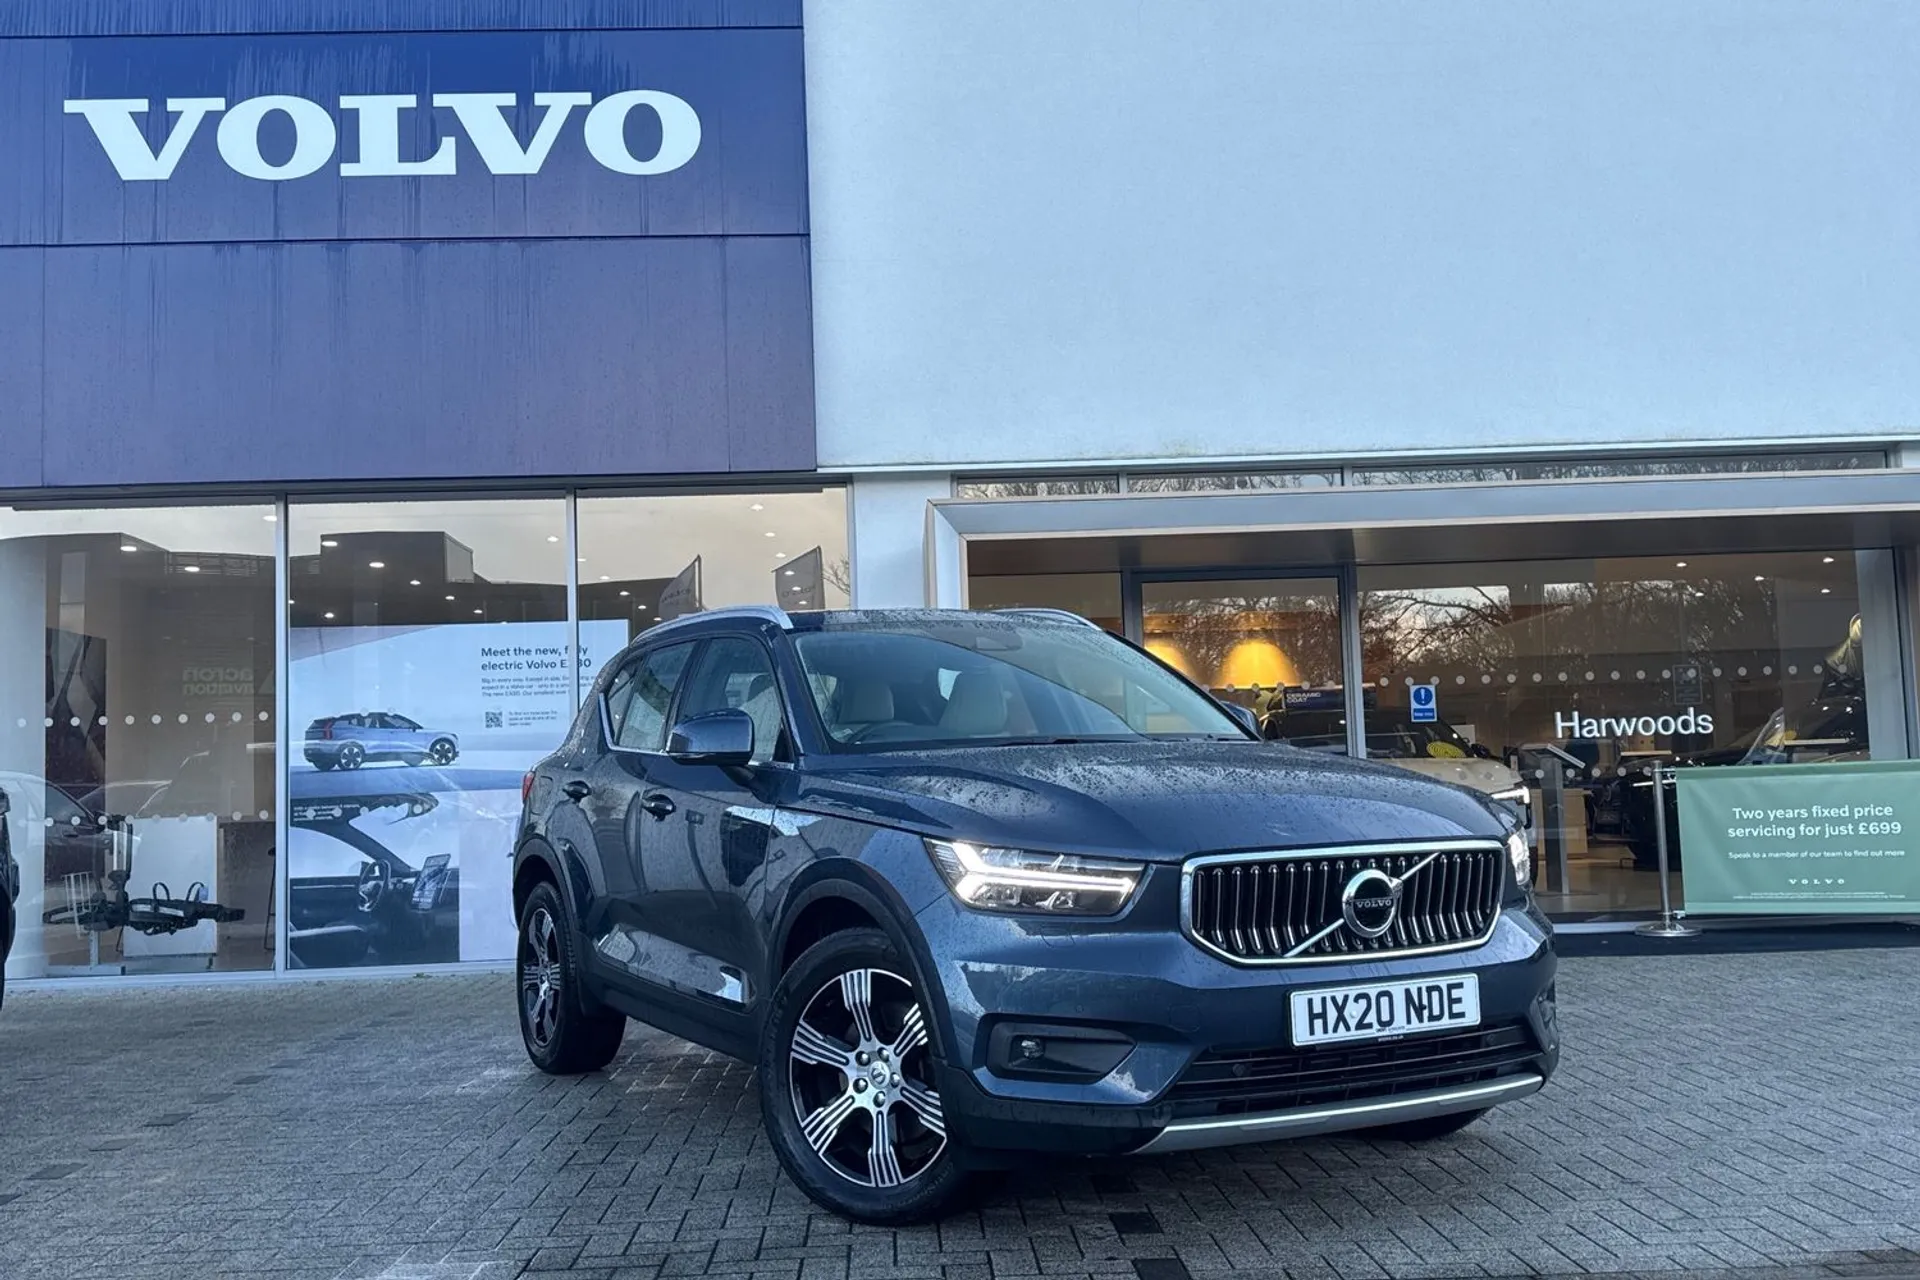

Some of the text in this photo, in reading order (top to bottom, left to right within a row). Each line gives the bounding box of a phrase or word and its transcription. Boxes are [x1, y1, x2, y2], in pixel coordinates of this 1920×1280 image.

[64, 89, 702, 182] VOLVO
[481, 647, 511, 657] Meet
[514, 646, 532, 656] the
[535, 647, 561, 656] new,
[481, 658, 592, 670] electric Volvo E30
[1554, 706, 1714, 738] Harwoods
[1732, 804, 1893, 821] Two years fixed price
[1727, 821, 1902, 839] servicing for just £699
[1800, 850, 1808, 858] of
[1356, 900, 1392, 908] VOLVO
[1307, 982, 1466, 1036] HX20 NDE
